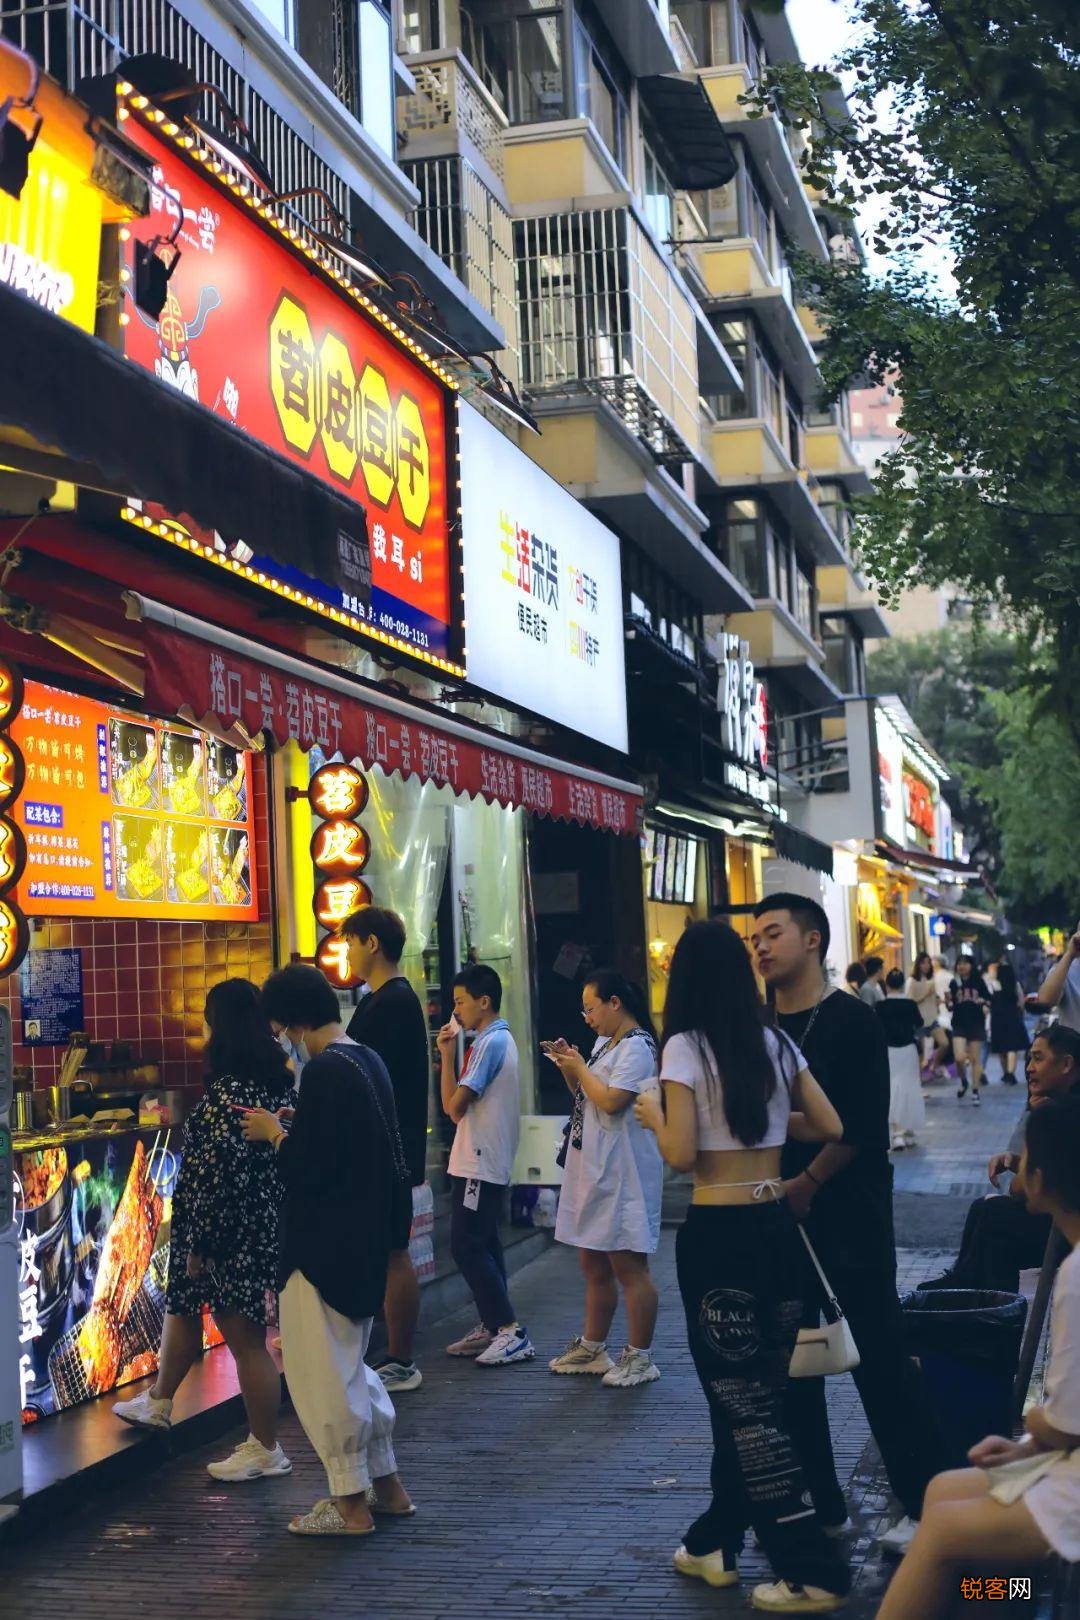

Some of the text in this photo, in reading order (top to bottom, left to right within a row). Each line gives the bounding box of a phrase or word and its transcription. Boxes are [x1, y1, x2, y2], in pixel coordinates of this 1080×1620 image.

[277, 328, 424, 496] 苕皮豆干
[316, 769, 363, 980] 苕皮豆干
